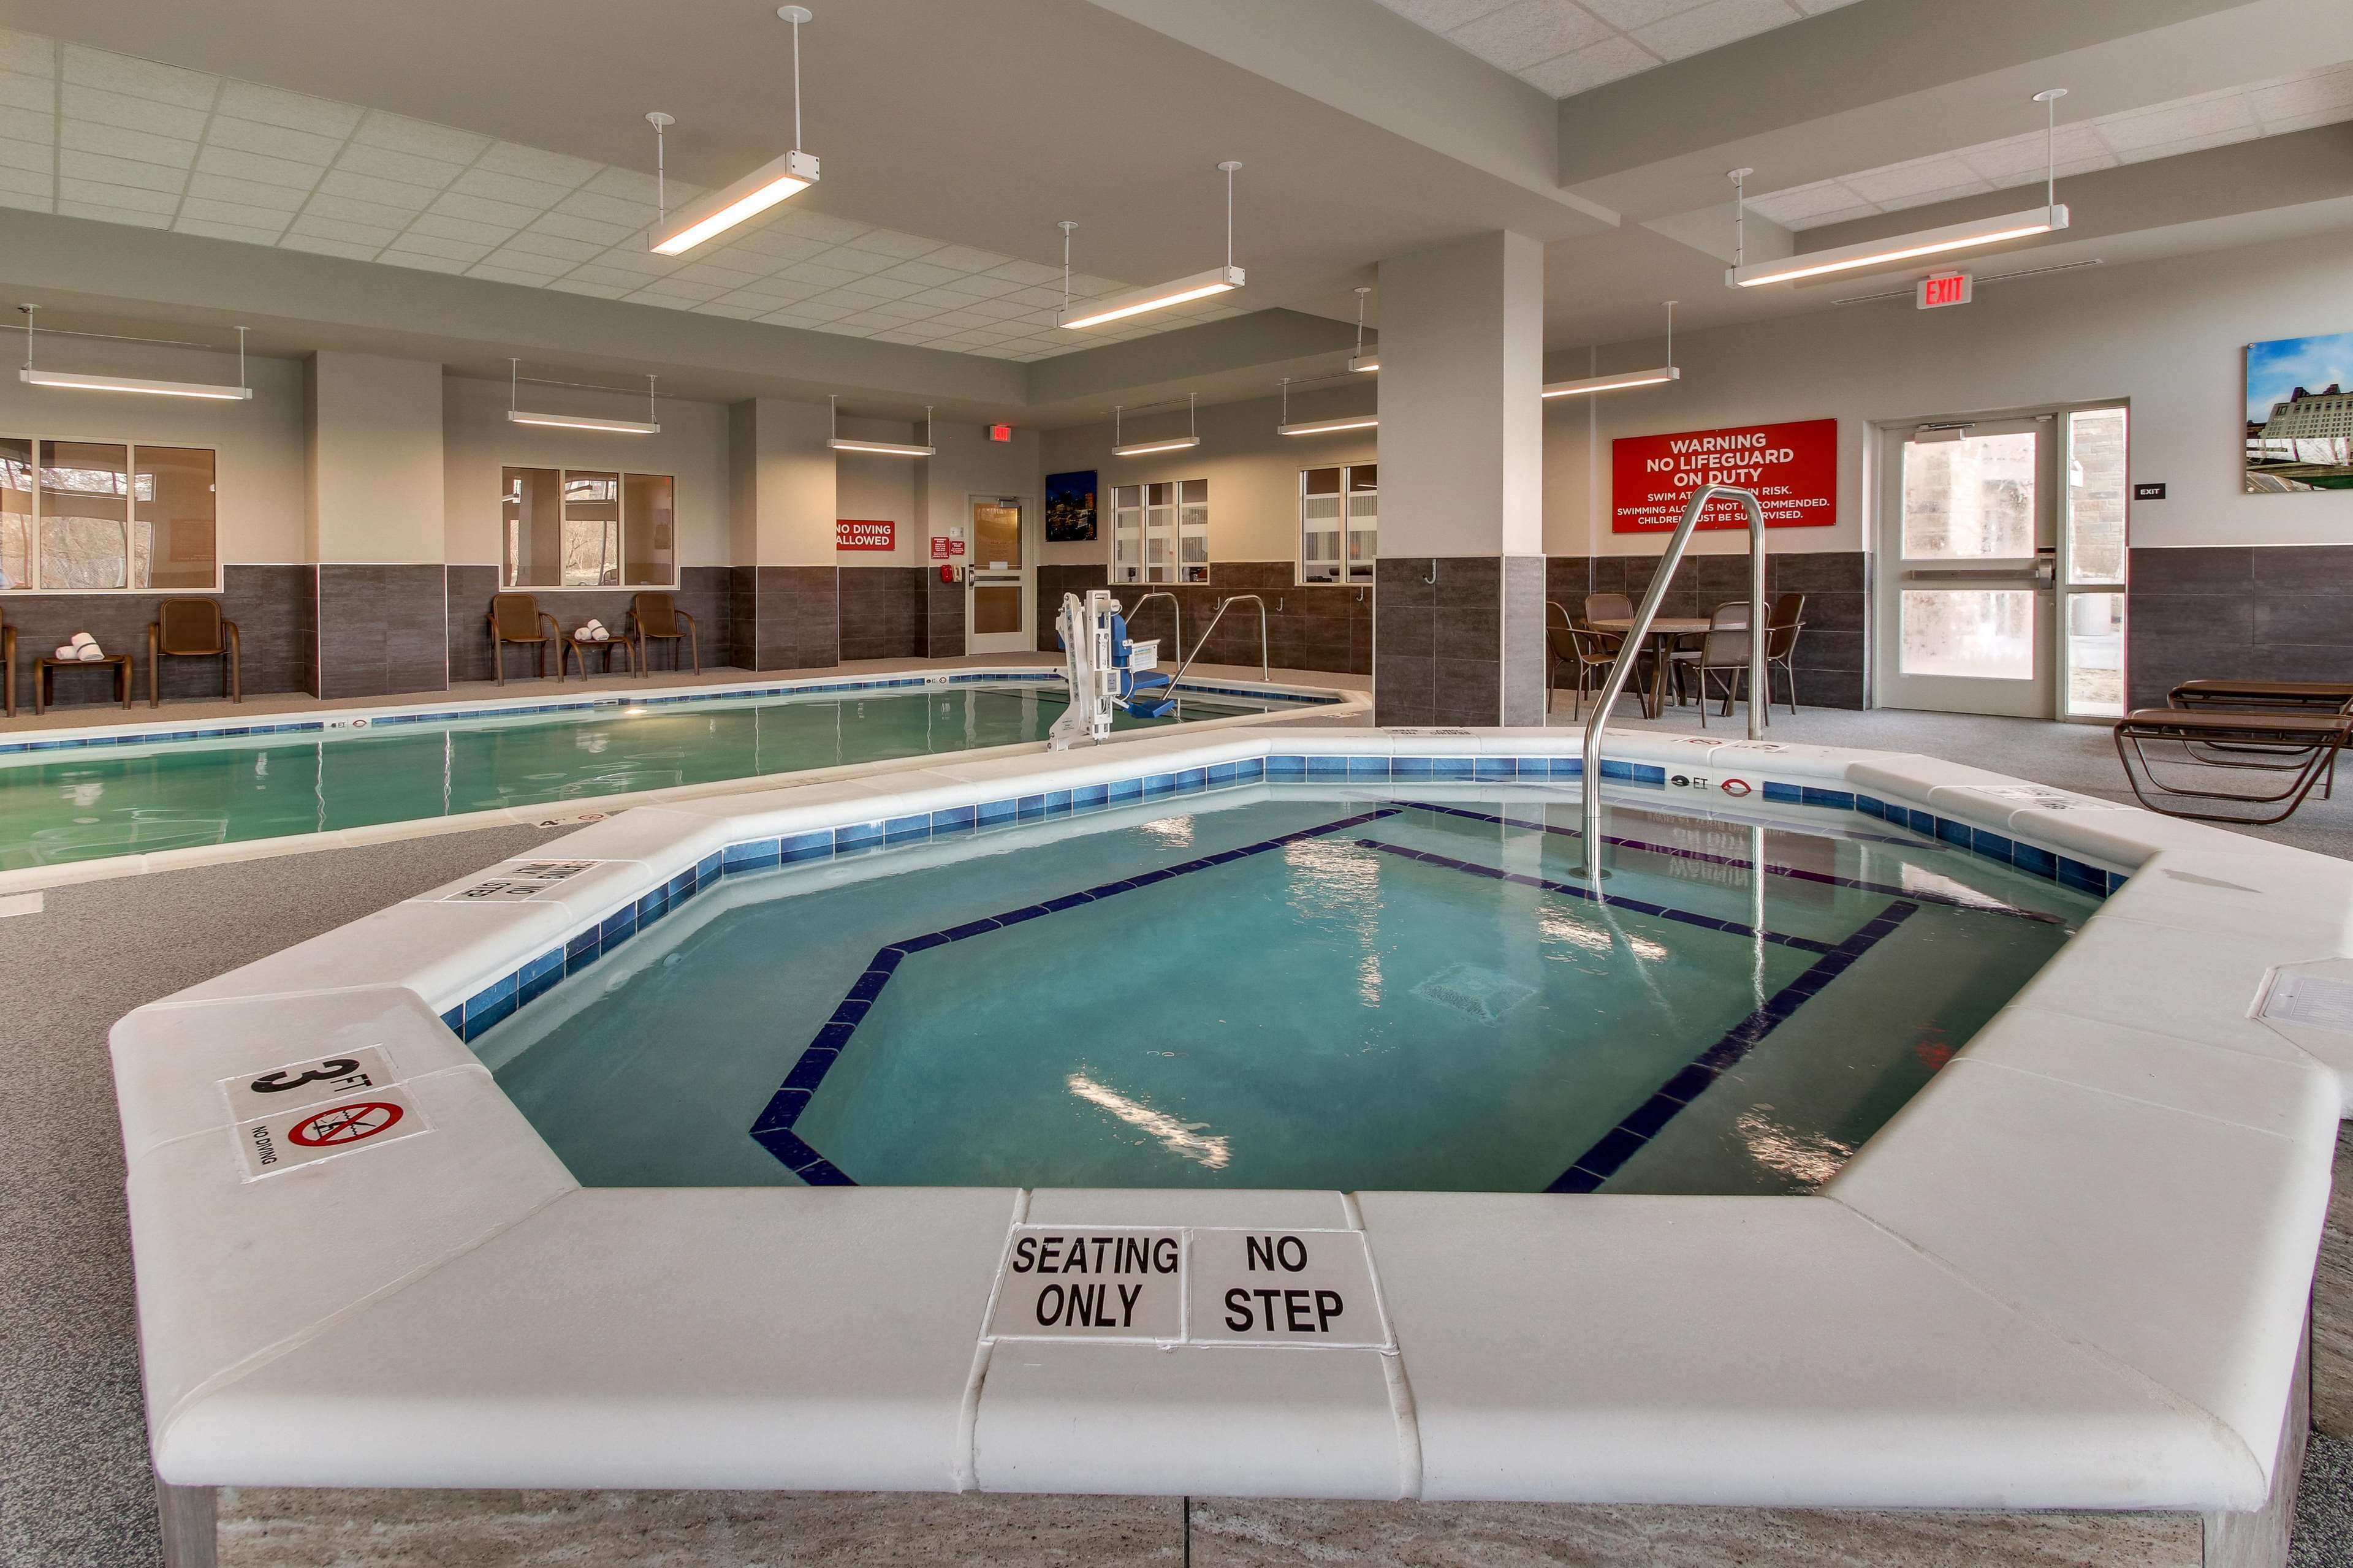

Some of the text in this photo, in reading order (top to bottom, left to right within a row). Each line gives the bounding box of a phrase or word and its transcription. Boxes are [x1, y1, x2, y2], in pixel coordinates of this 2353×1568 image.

[1926, 276, 1964, 305] EXIT
[1670, 433, 1766, 454] WARNING
[1646, 448, 1794, 472] NO LIFEGUARD
[1673, 468, 1763, 487] ON DUTY
[1647, 492, 1676, 502] SWIM
[1679, 491, 1693, 500] AT
[1762, 485, 1793, 496] RISK.
[1617, 506, 1666, 515] SWIMMING
[1668, 505, 1689, 513] ALO
[1716, 502, 1739, 511] NOT
[1718, 513, 1731, 521] BE
[1735, 510, 1803, 521] SURVISED.
[853, 525, 891, 534] DIVING
[836, 535, 889, 545] ALLOWED
[460, 882, 512, 898] STEP
[505, 885, 545, 895] NO
[250, 1058, 360, 1093] 3
[329, 1073, 373, 1093] FT
[251, 1125, 278, 1166] NO DIVING
[1012, 1236, 1179, 1274] SEATING
[1245, 1235, 1308, 1273] NO
[1035, 1283, 1143, 1328] ONLY
[1225, 1287, 1344, 1333] STEP
